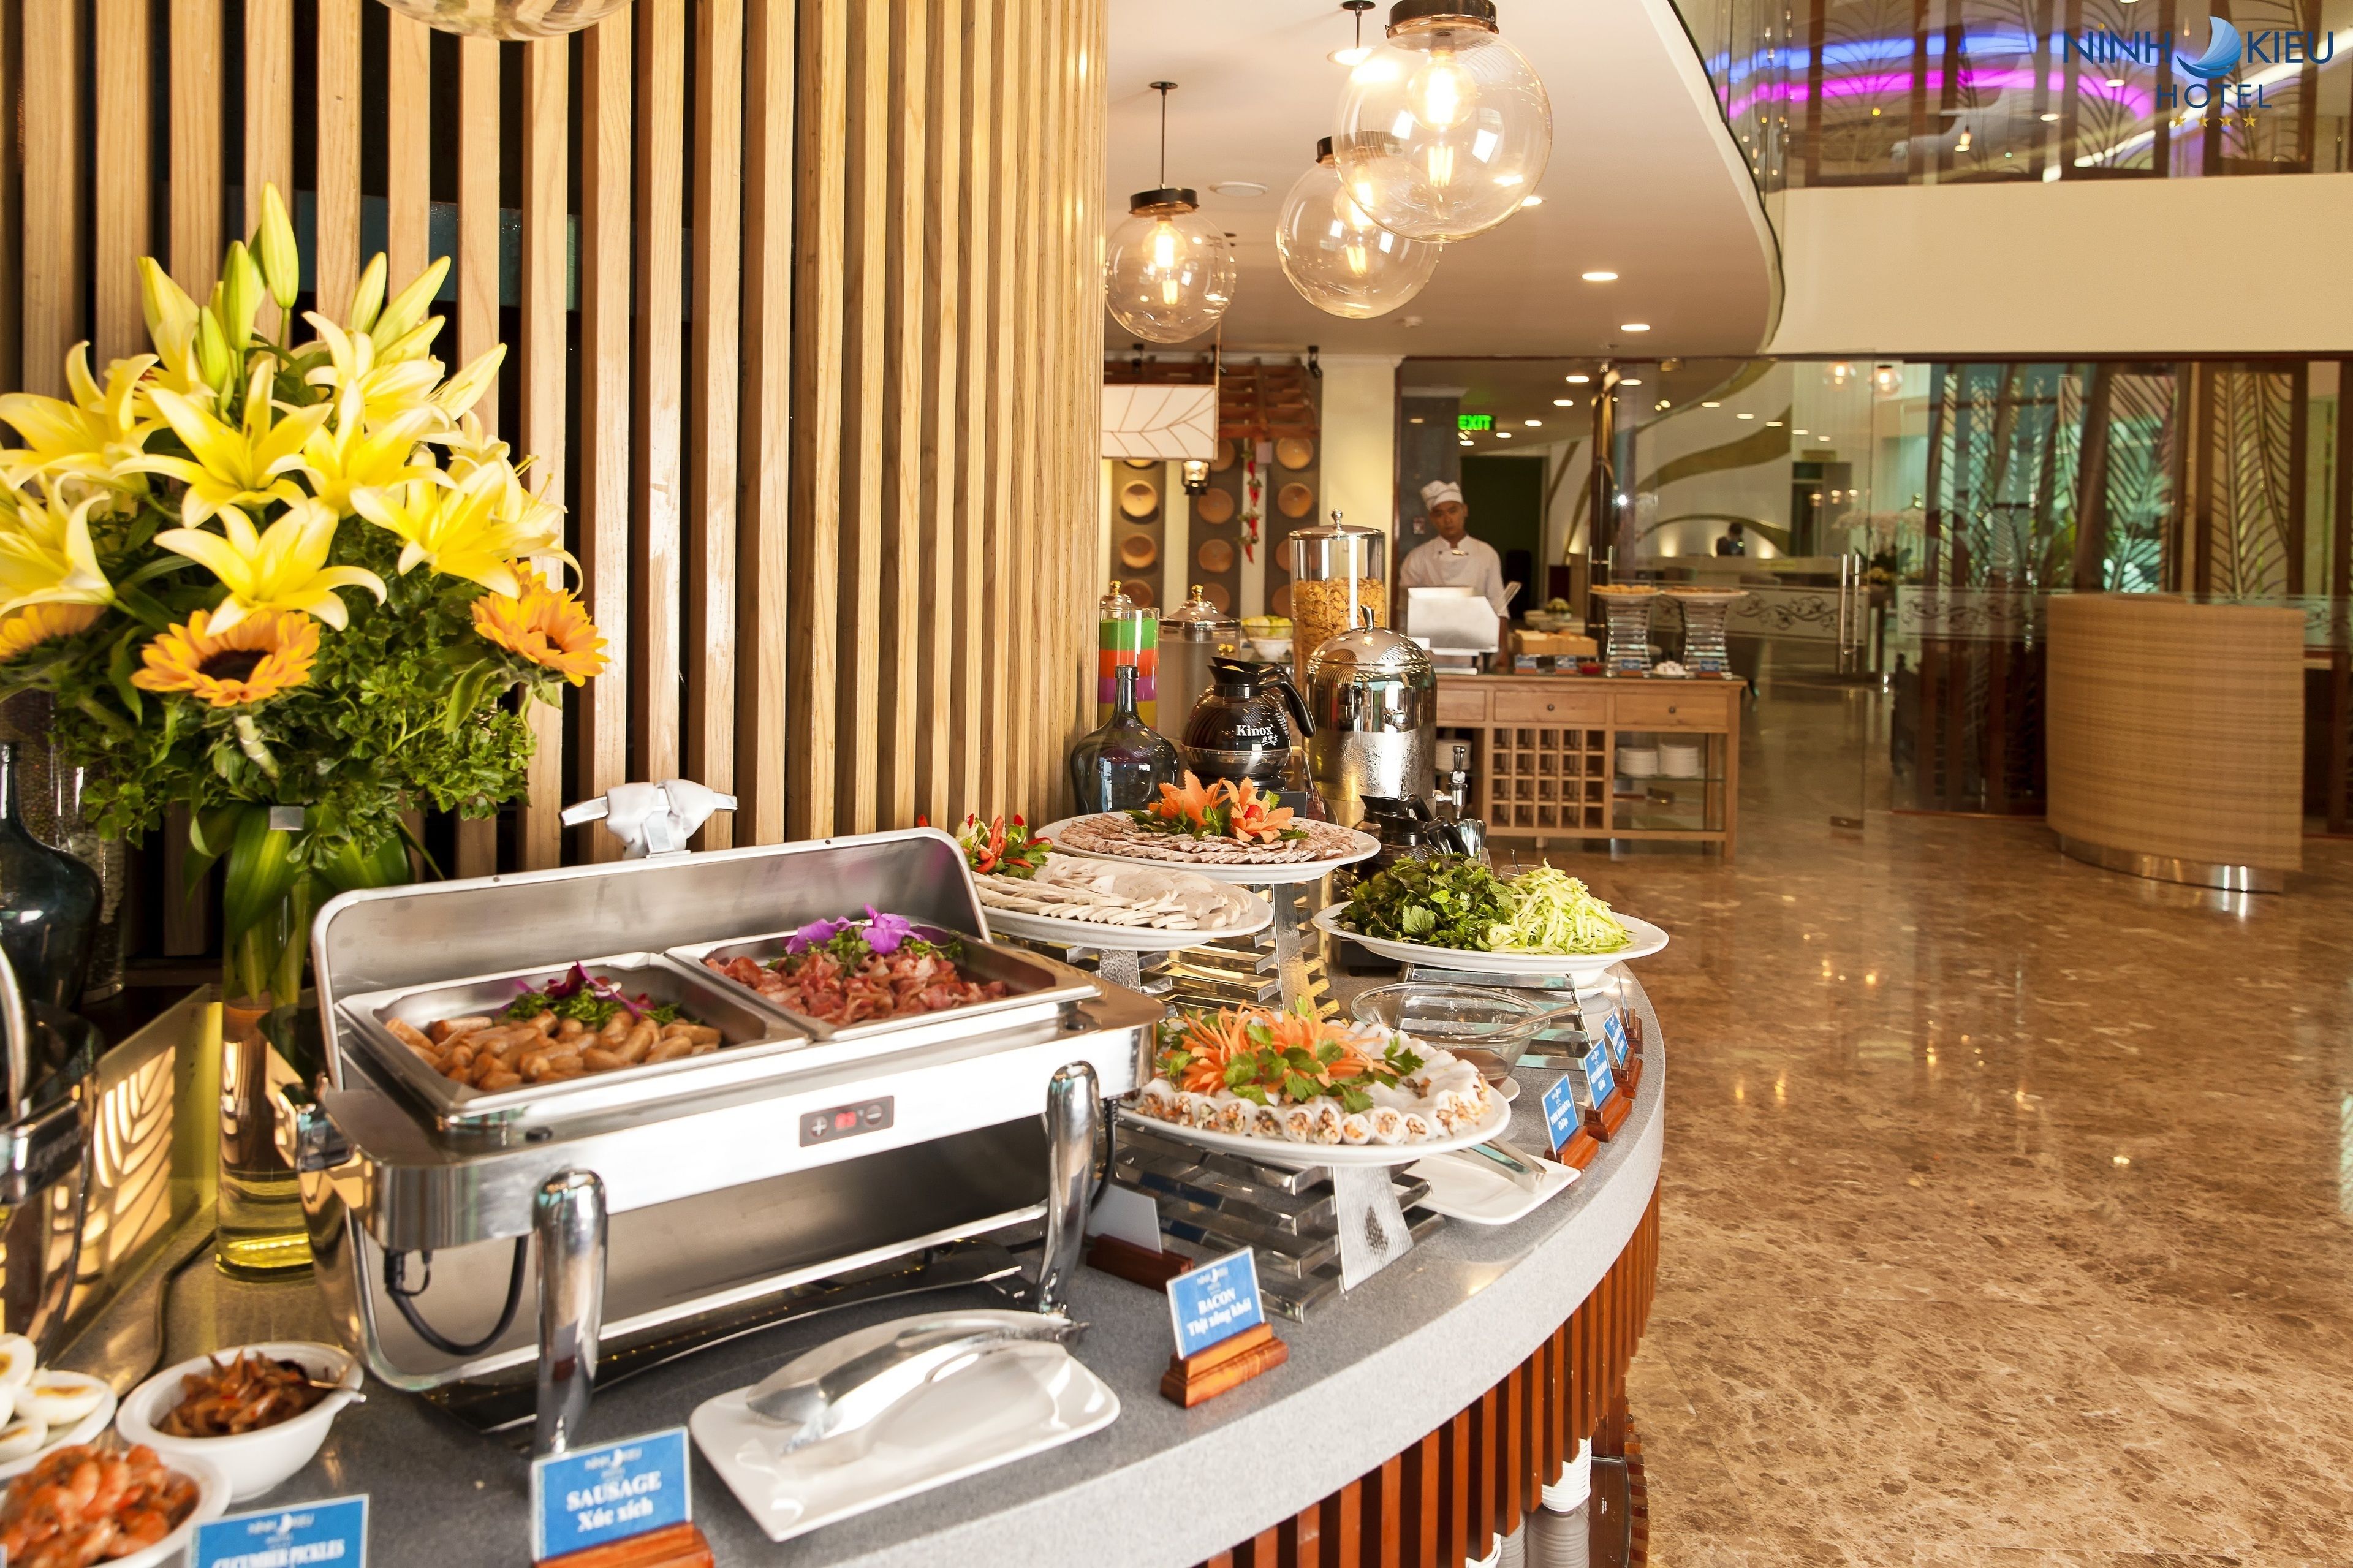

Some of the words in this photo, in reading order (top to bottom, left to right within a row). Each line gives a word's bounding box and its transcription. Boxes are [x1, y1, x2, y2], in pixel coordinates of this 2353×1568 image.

[1458, 414, 1492, 431] EXIT
[1236, 724, 1273, 736] Kinox
[1197, 1287, 1236, 1315] BACON
[566, 1470, 662, 1512] SAUSAGE
[617, 1497, 654, 1523] xích
